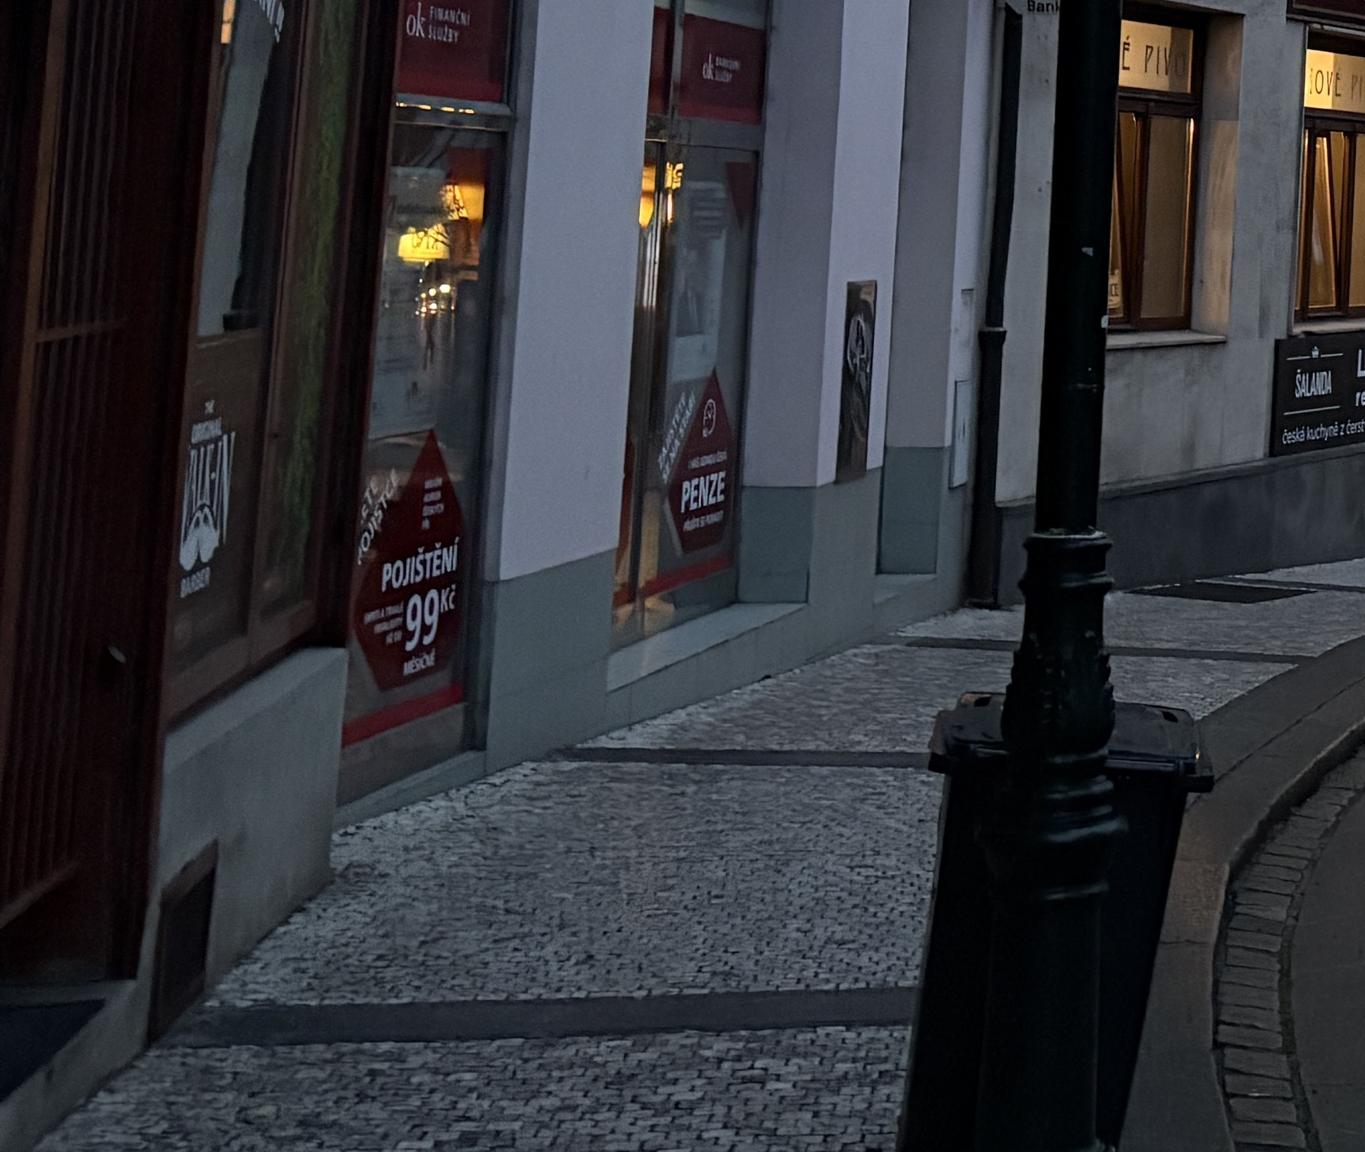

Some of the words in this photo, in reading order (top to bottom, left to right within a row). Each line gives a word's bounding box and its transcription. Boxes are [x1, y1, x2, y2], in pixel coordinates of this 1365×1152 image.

[406, 1, 426, 38] ok
[1295, 369, 1332, 398] ŠALANDA
[1282, 426, 1305, 445] česká
[1306, 421, 1339, 441] kuchyně
[1340, 423, 1345, 436] z
[680, 470, 727, 514] PENZE
[381, 535, 460, 593] POJIŠTĚNÍ
[404, 588, 440, 652] 99
[440, 583, 457, 614] Kč
